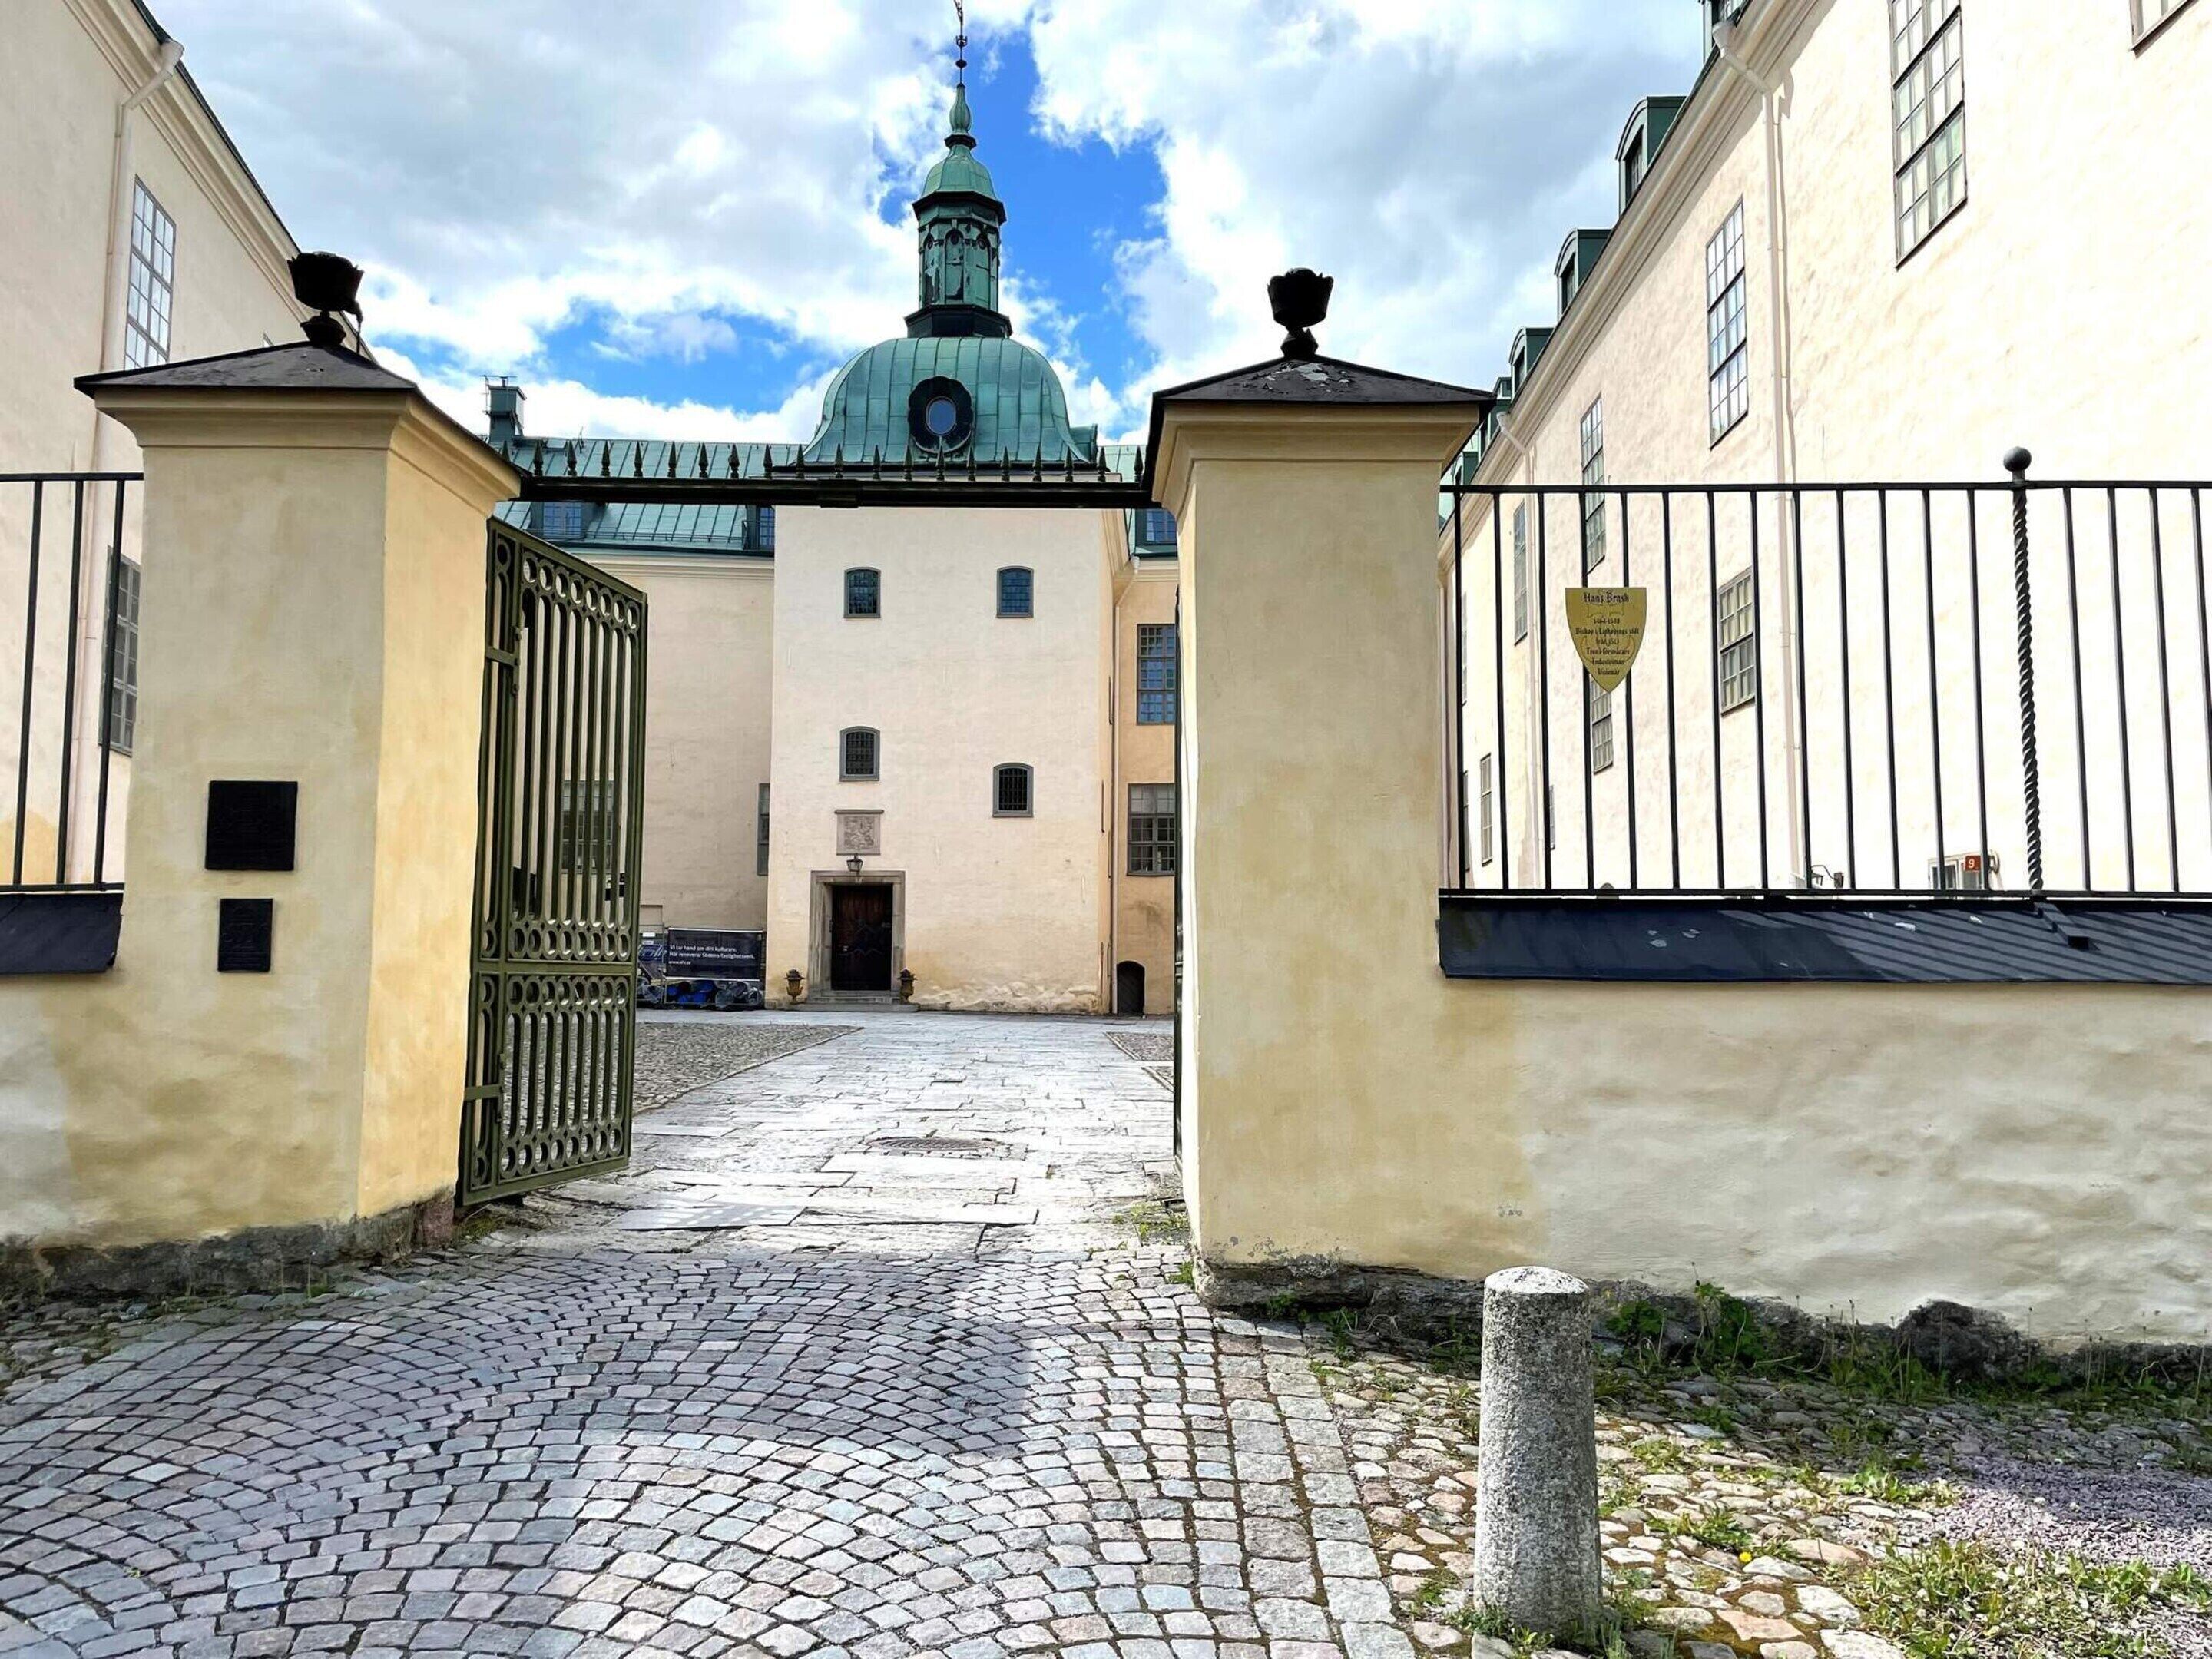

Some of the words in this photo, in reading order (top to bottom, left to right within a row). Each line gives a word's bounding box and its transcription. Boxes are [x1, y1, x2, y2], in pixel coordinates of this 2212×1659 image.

[1584, 592, 1604, 602] Hans
[1606, 591, 1629, 602] Brask
[1969, 859, 1975, 869] 9
